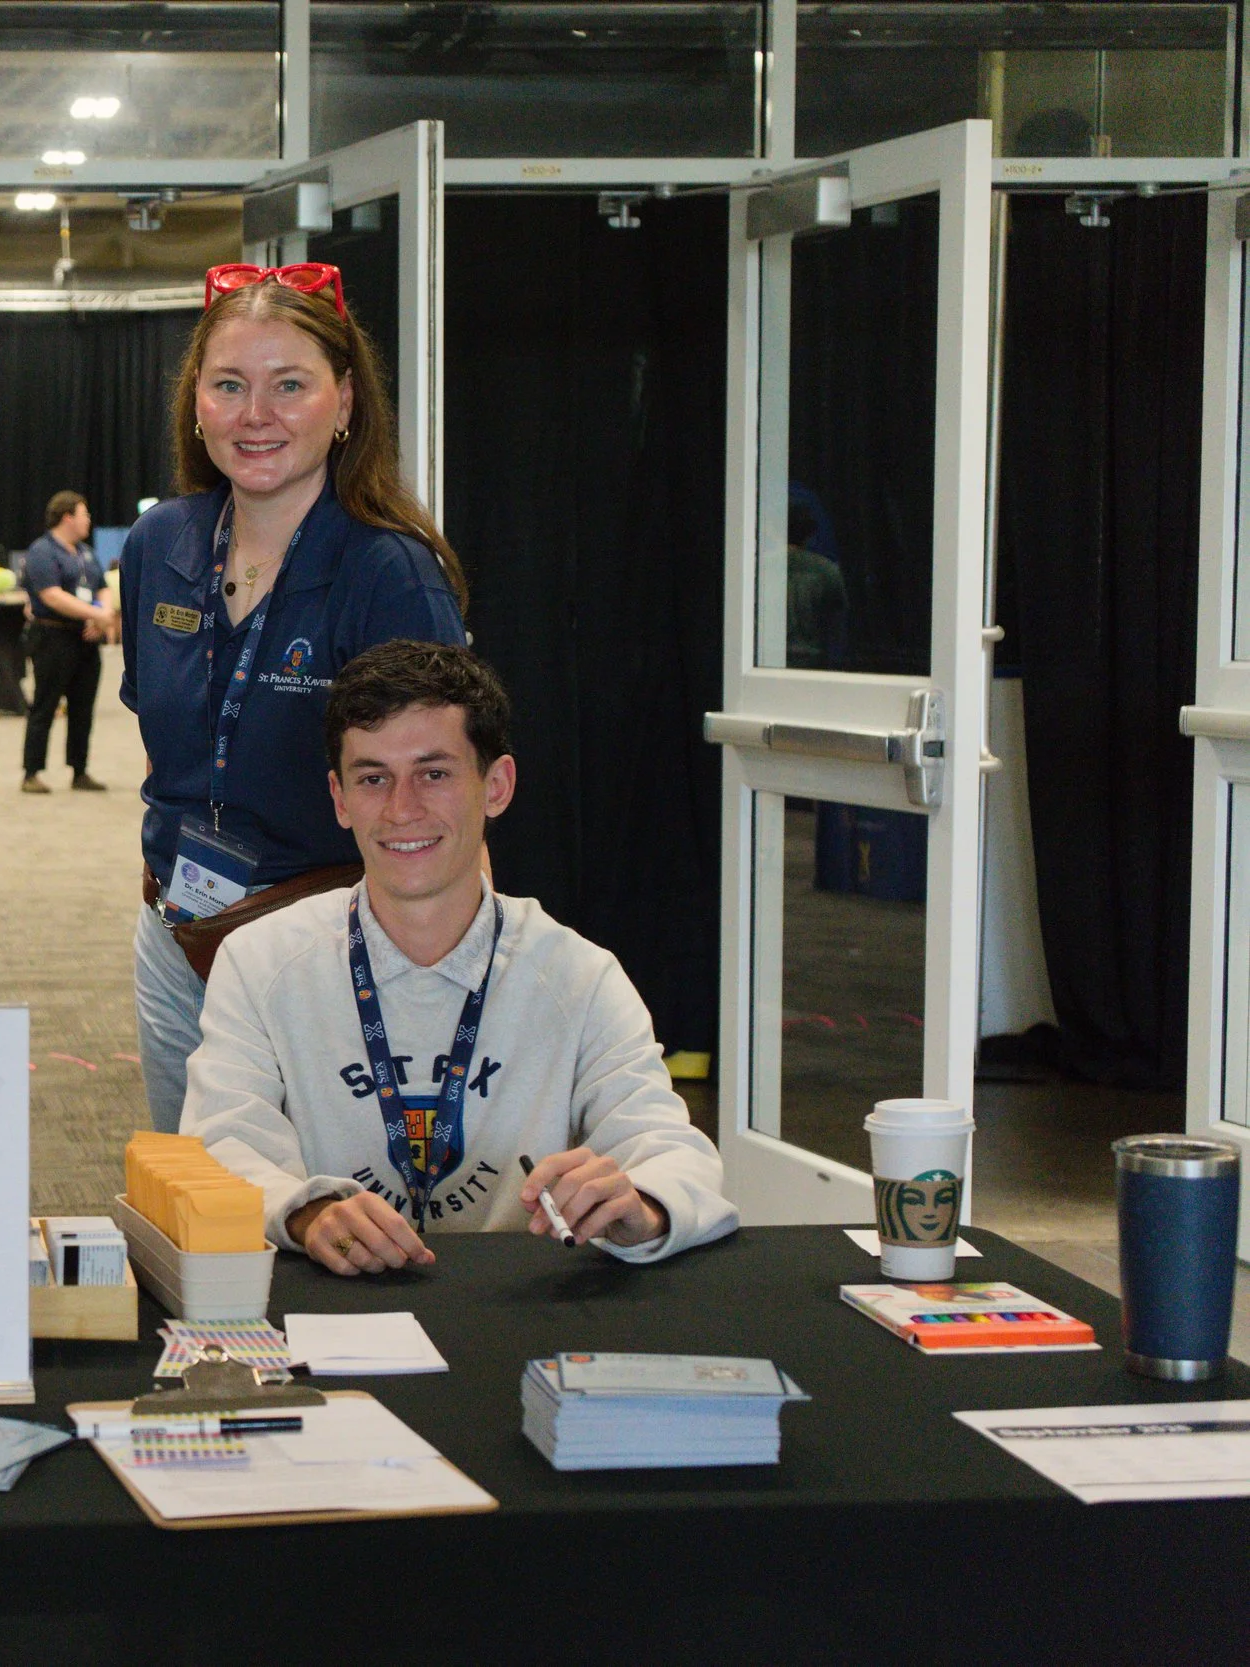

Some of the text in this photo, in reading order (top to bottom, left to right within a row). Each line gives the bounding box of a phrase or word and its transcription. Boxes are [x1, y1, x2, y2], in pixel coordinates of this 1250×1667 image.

[270, 673, 301, 685] FRANCIS
[274, 685, 312, 694] UNIVERSITY
[195, 888, 208, 899] Erin
[209, 895, 229, 908] Morto
